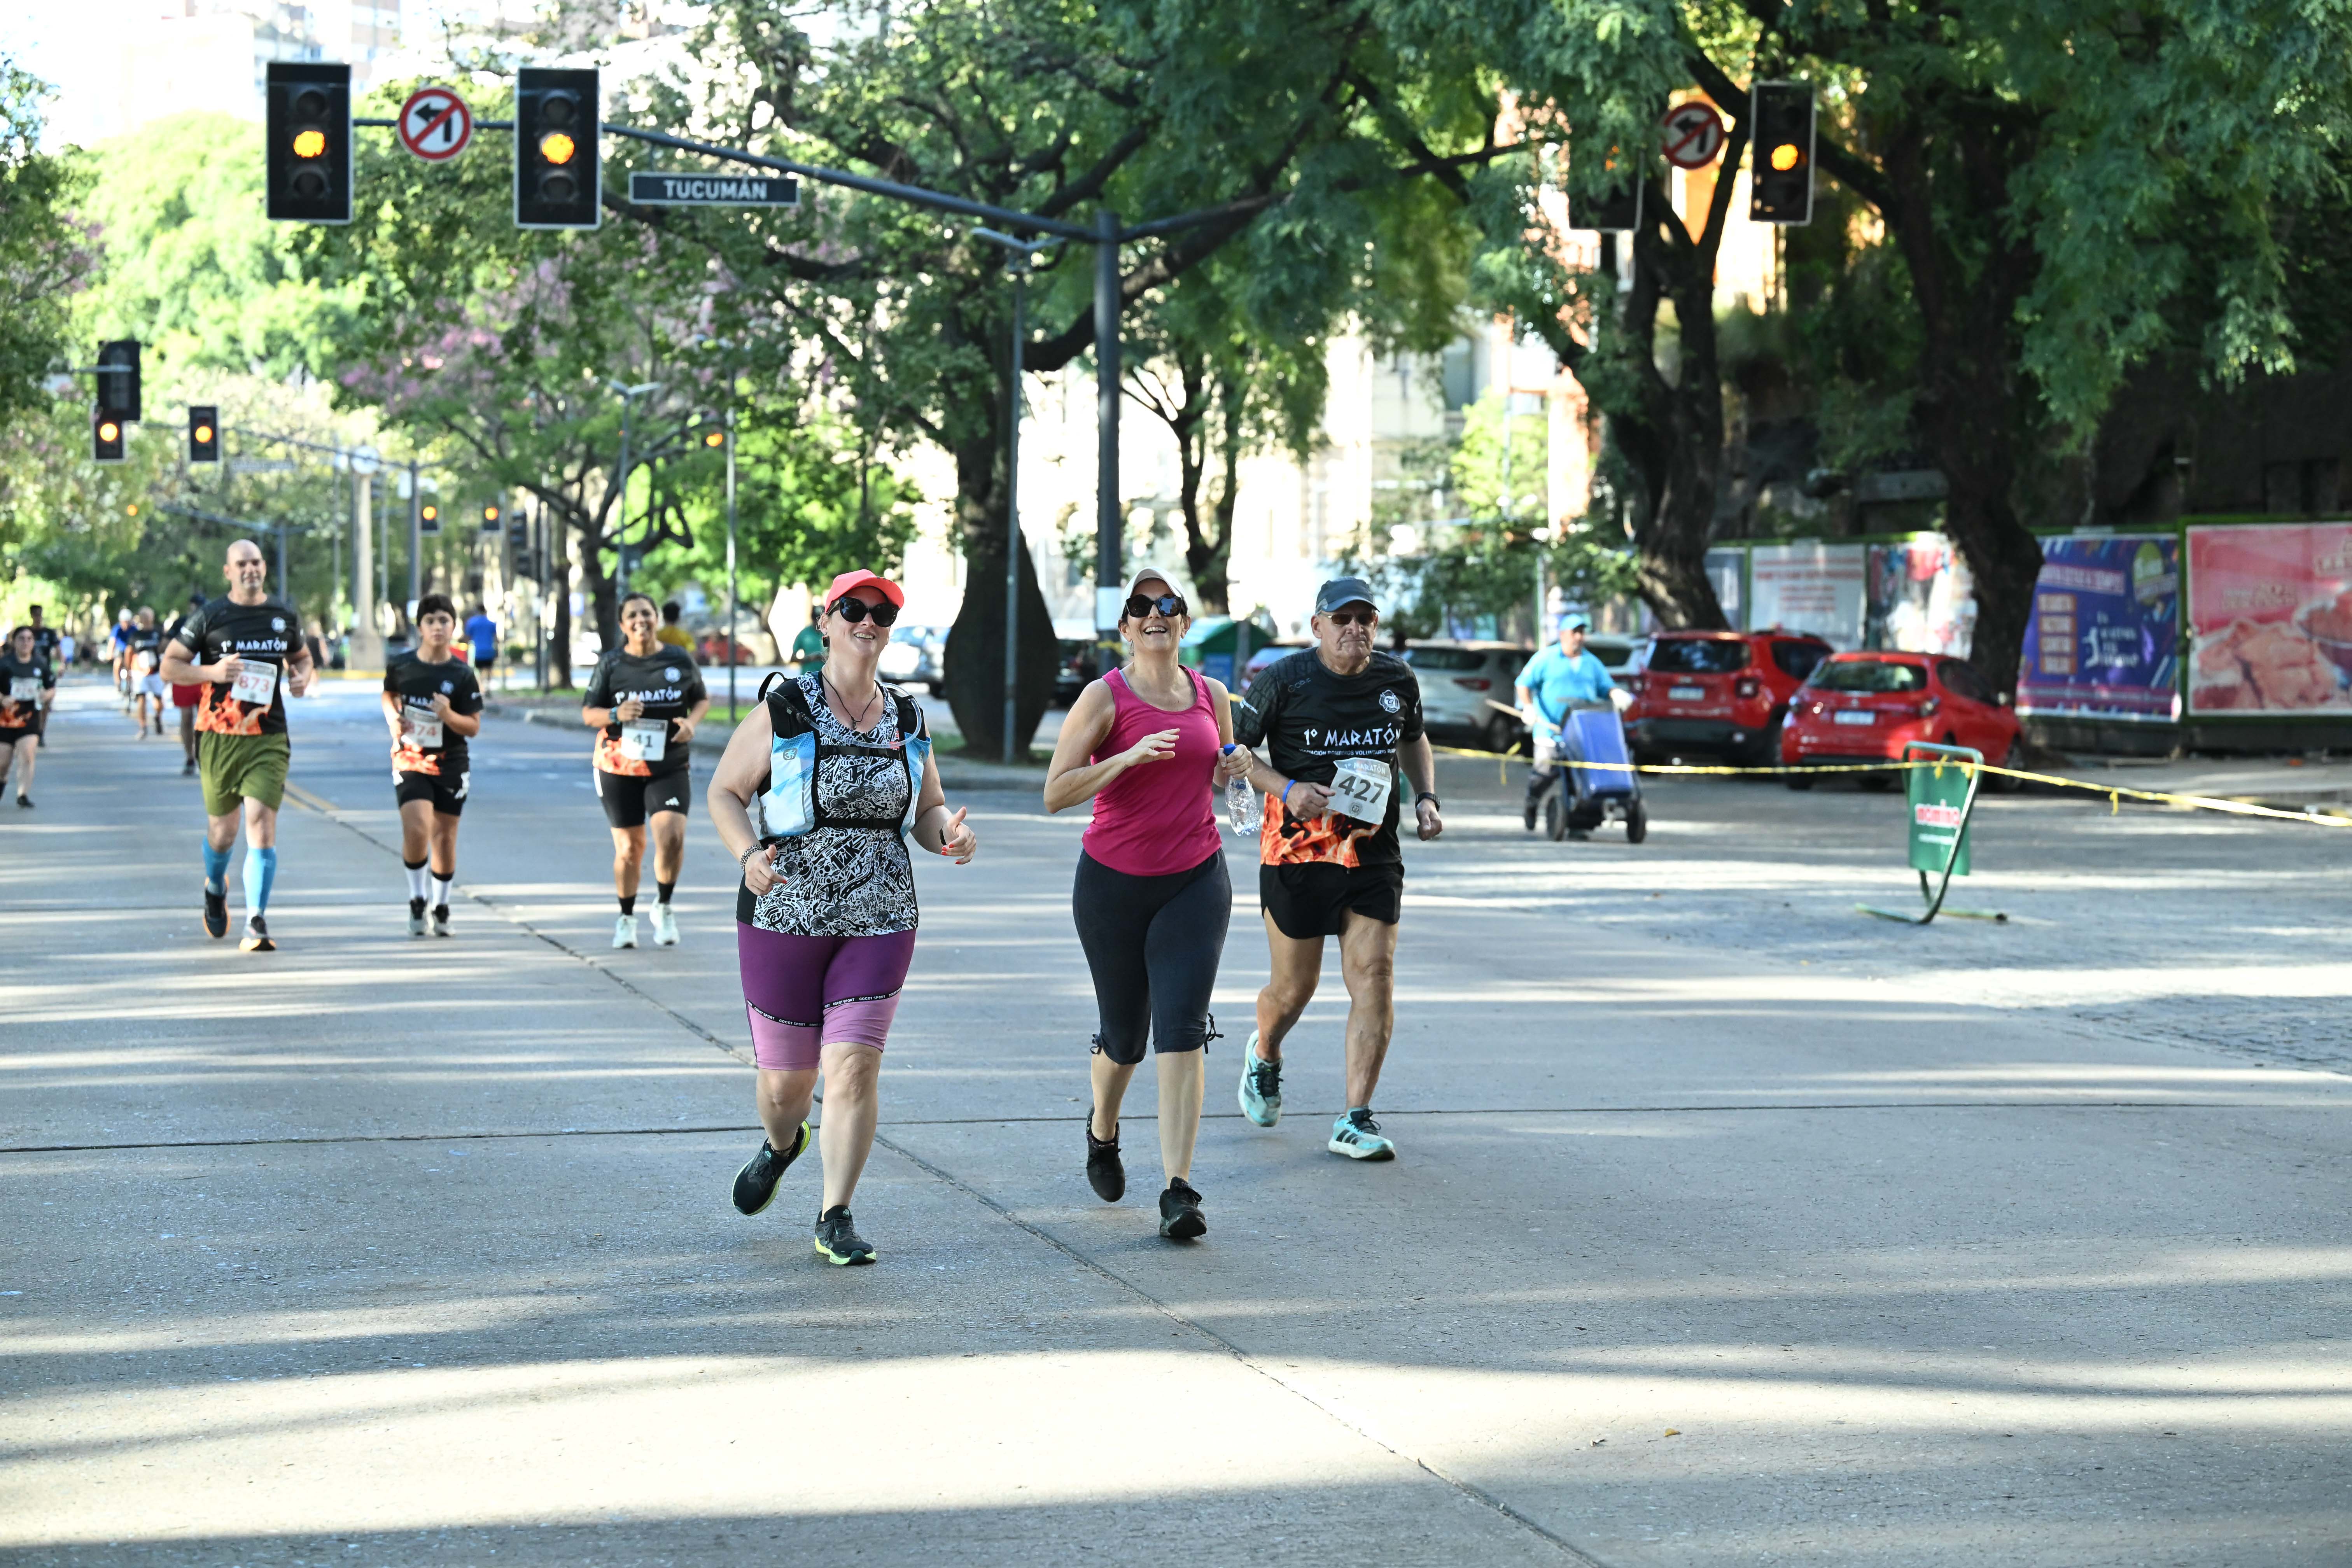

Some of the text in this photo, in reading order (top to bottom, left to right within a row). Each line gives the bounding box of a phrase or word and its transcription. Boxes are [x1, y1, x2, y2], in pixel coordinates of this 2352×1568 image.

[663, 177, 768, 200] TUCUMÁN
[236, 637, 288, 652] MARATÓN
[239, 674, 270, 693] 873
[634, 734, 653, 747] 41
[1324, 722, 1401, 747] MARATÓN
[1354, 762, 1386, 775] MARATÓN
[1338, 775, 1384, 804] 427
